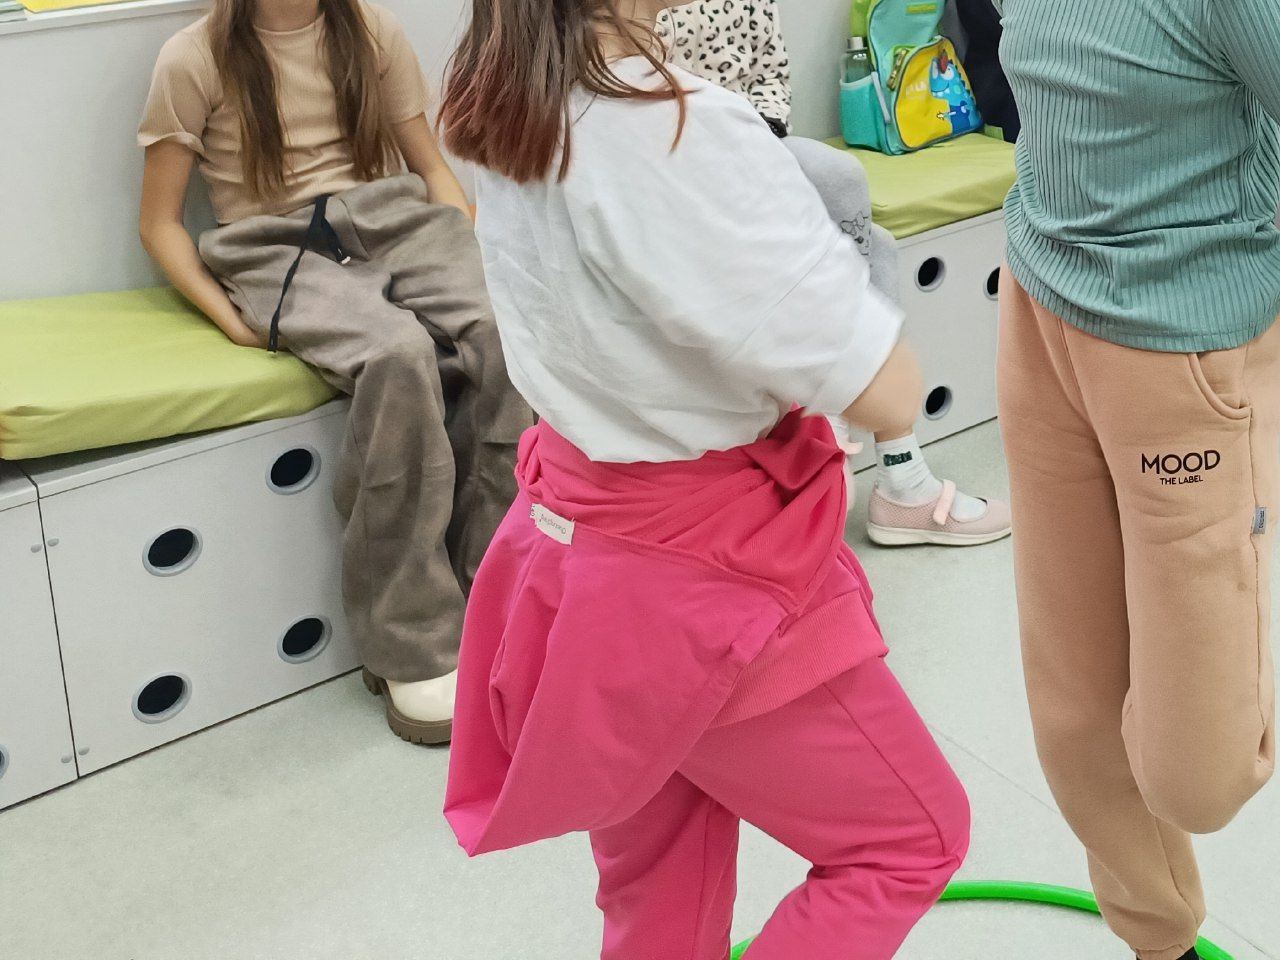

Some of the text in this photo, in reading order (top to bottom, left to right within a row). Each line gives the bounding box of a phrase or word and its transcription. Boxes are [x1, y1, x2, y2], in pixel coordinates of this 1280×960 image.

[1141, 450, 1221, 474] MOOD
[1160, 475, 1204, 485] THE LABEL
